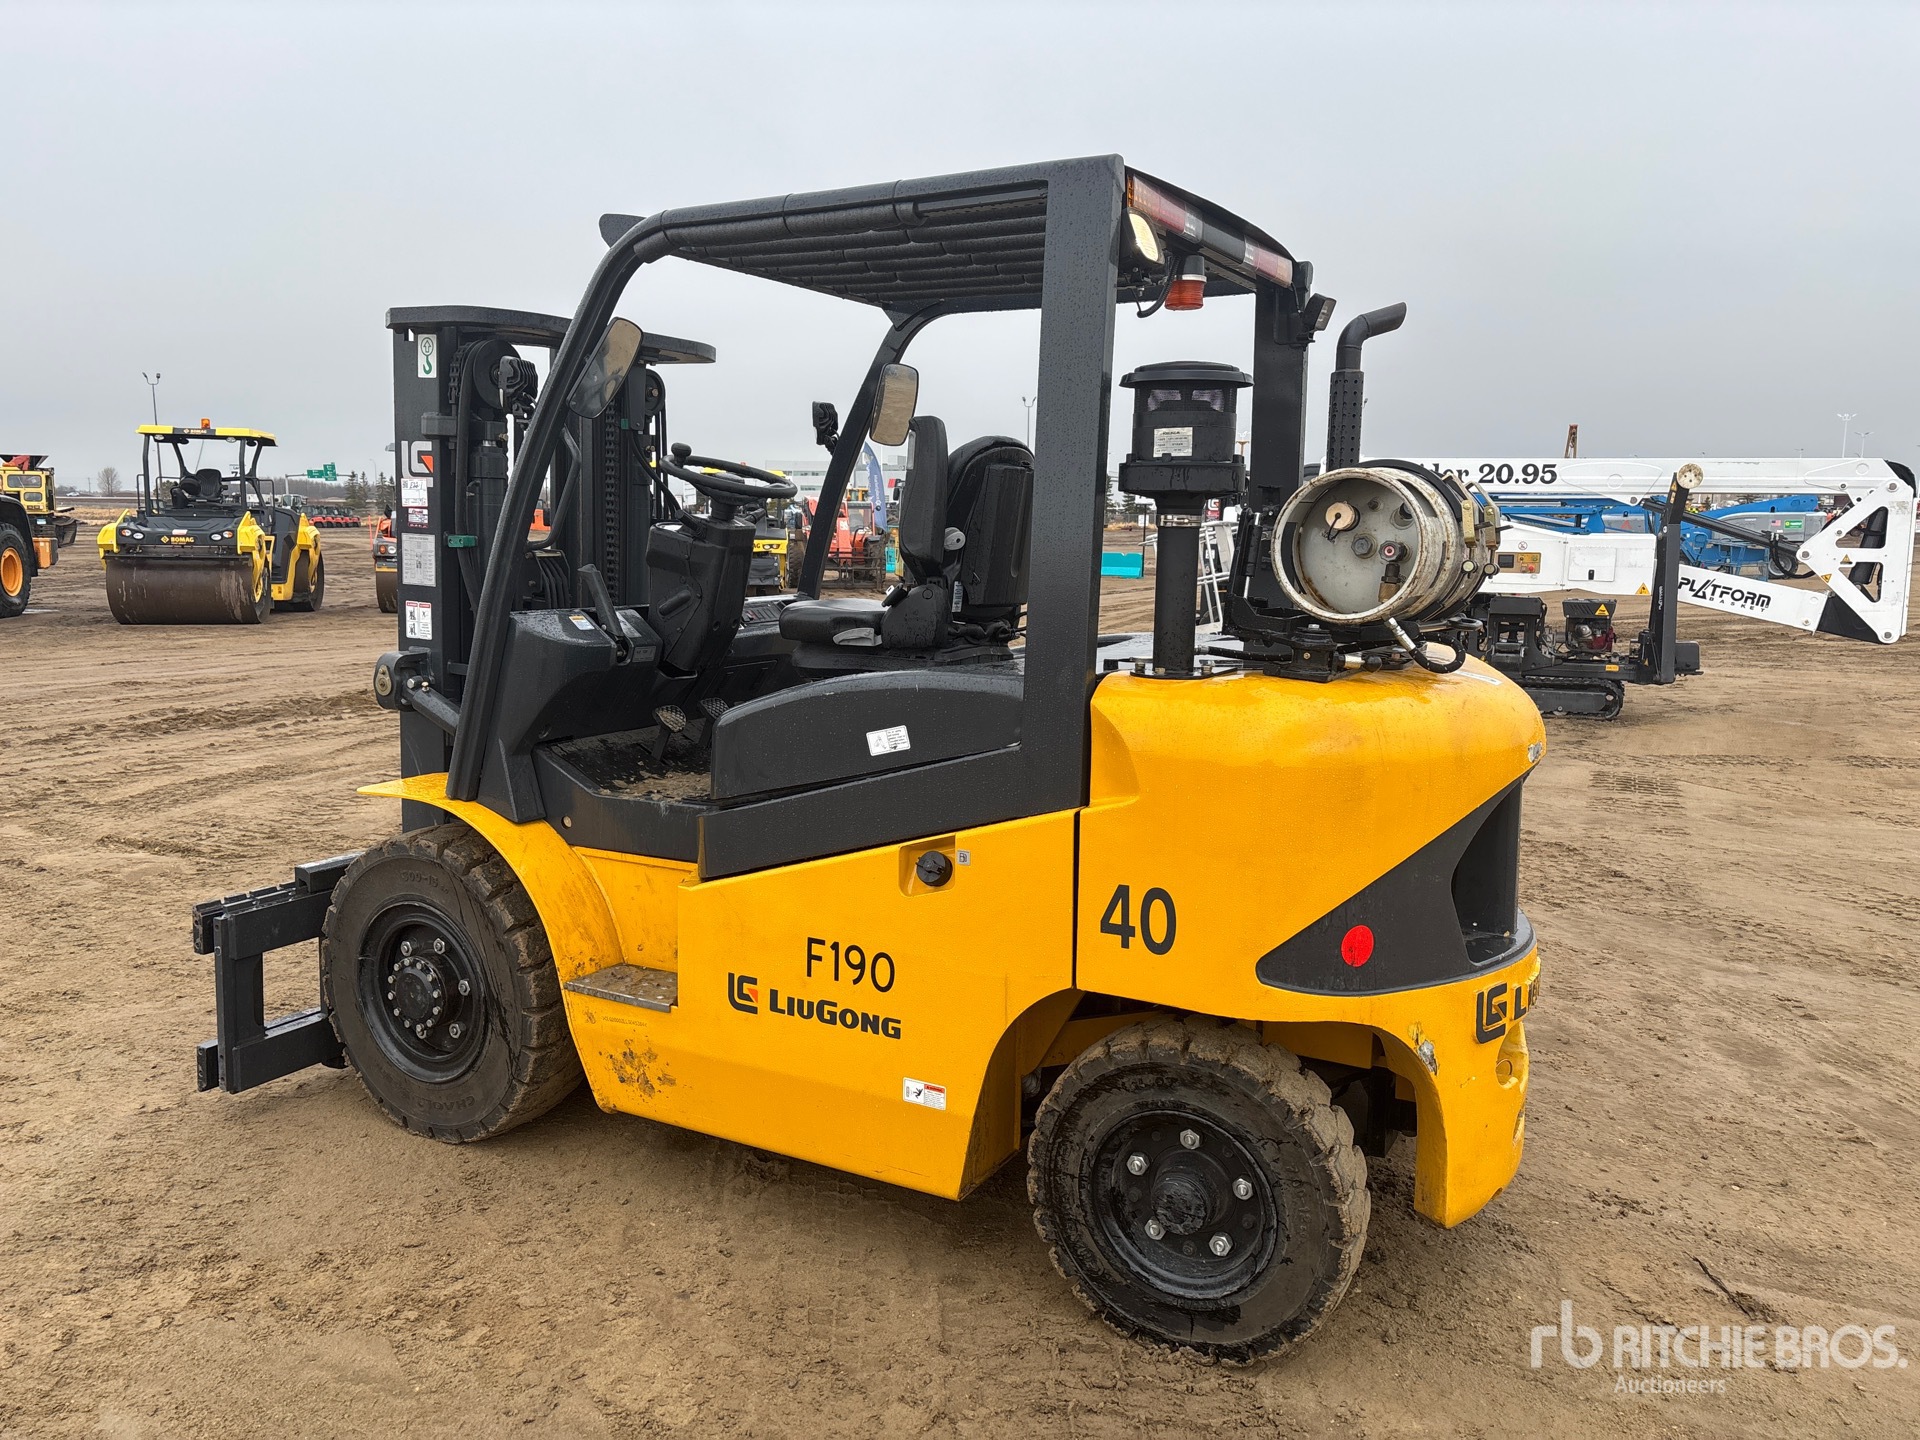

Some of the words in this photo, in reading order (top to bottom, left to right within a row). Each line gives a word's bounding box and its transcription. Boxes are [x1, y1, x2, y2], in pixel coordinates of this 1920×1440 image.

[1478, 463, 1557, 485] 20.95
[1678, 577, 1771, 607] PLATFORM
[1708, 596, 1766, 613] BASKET
[1100, 885, 1177, 955] 40
[806, 937, 896, 993] F190
